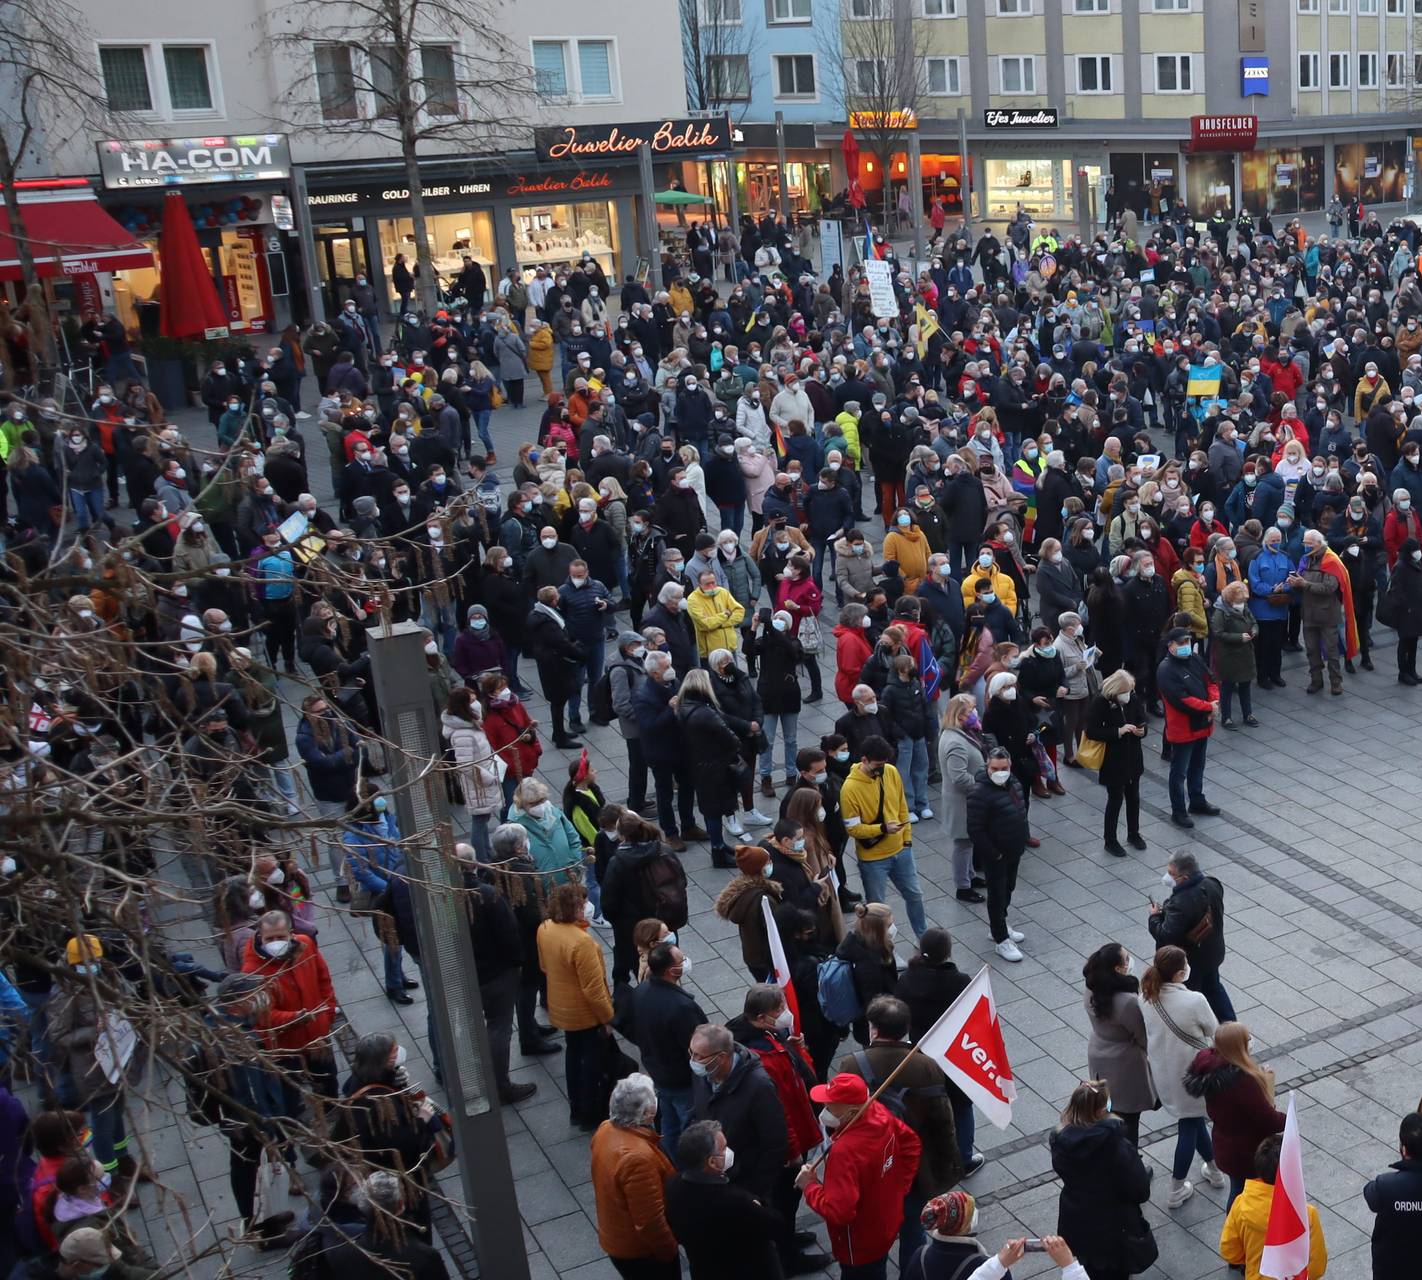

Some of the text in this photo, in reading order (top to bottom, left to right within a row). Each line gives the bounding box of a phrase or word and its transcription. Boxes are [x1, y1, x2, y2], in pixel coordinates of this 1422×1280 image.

[986, 110, 1055, 126] Efes Juwelier
[1199, 117, 1253, 130] HAUSFELDER
[549, 121, 719, 158] Juwelier Balik
[120, 146, 273, 172] HA-COM
[306, 193, 358, 205] RAURINGE
[382, 189, 410, 200] GOLD
[459, 183, 491, 194] UHREN
[507, 171, 613, 196] Juwelier Balik
